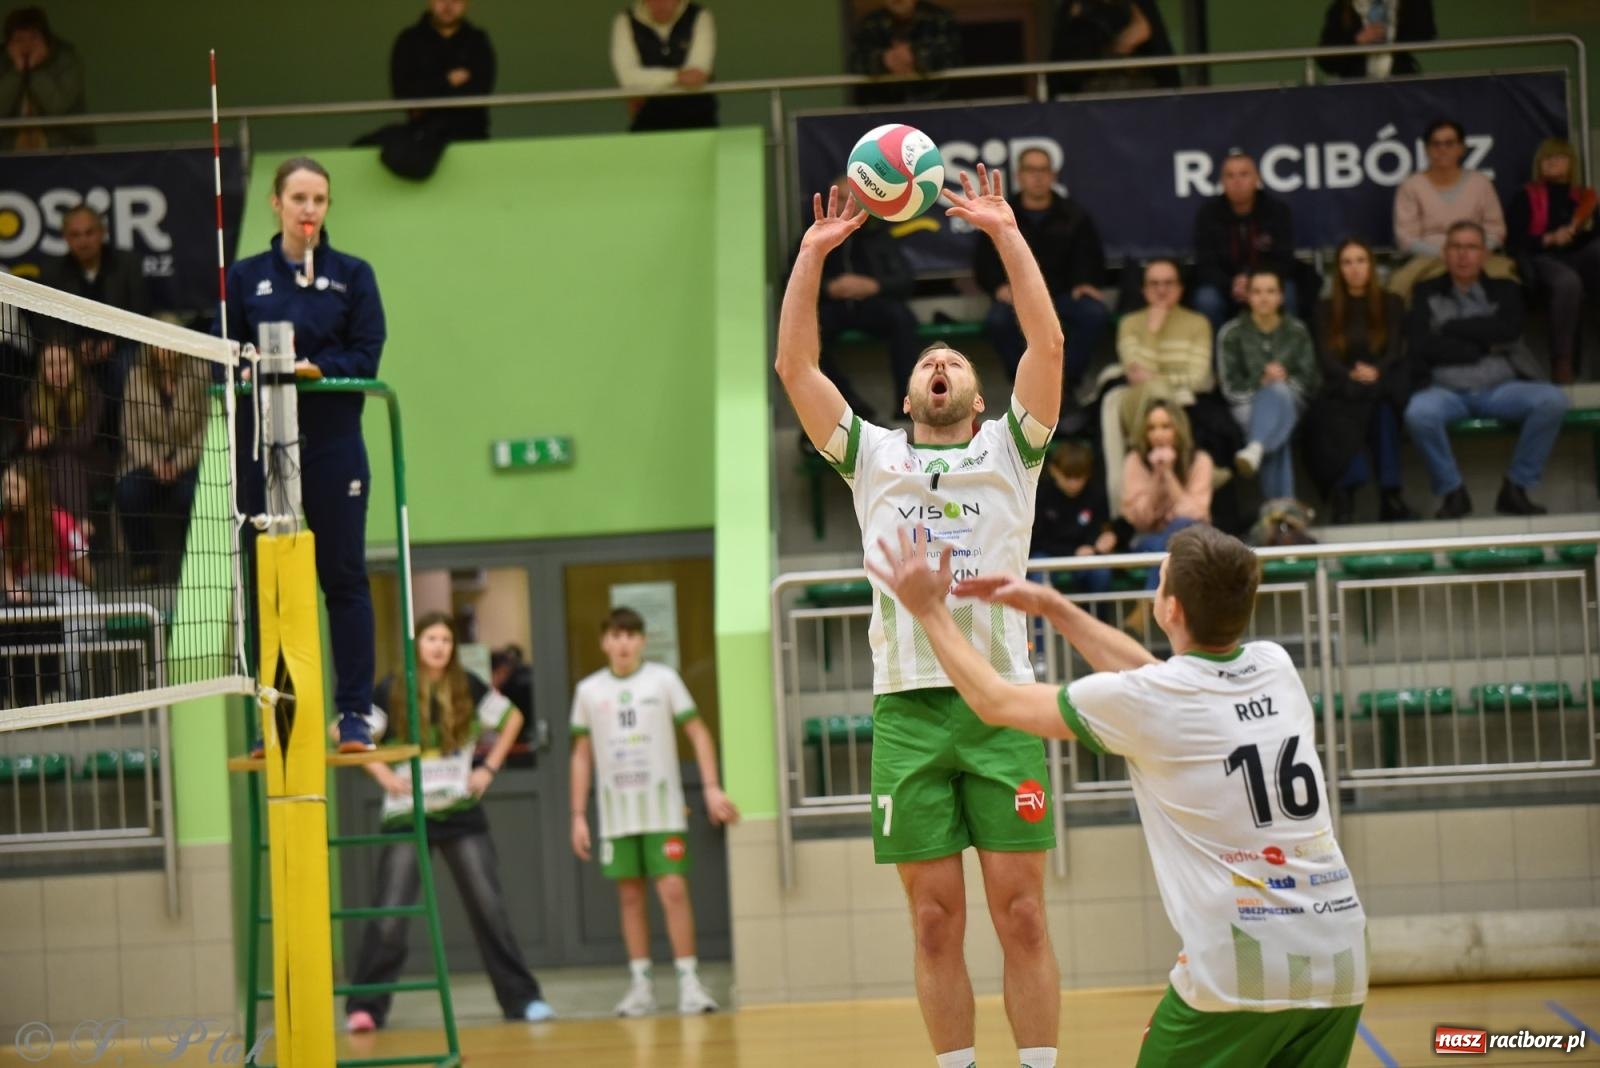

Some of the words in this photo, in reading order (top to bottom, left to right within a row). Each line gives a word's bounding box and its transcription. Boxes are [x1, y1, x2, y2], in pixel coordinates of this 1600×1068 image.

[856, 165, 887, 199] molten
[1223, 735, 1320, 829] 16
[877, 794, 893, 837] 7
